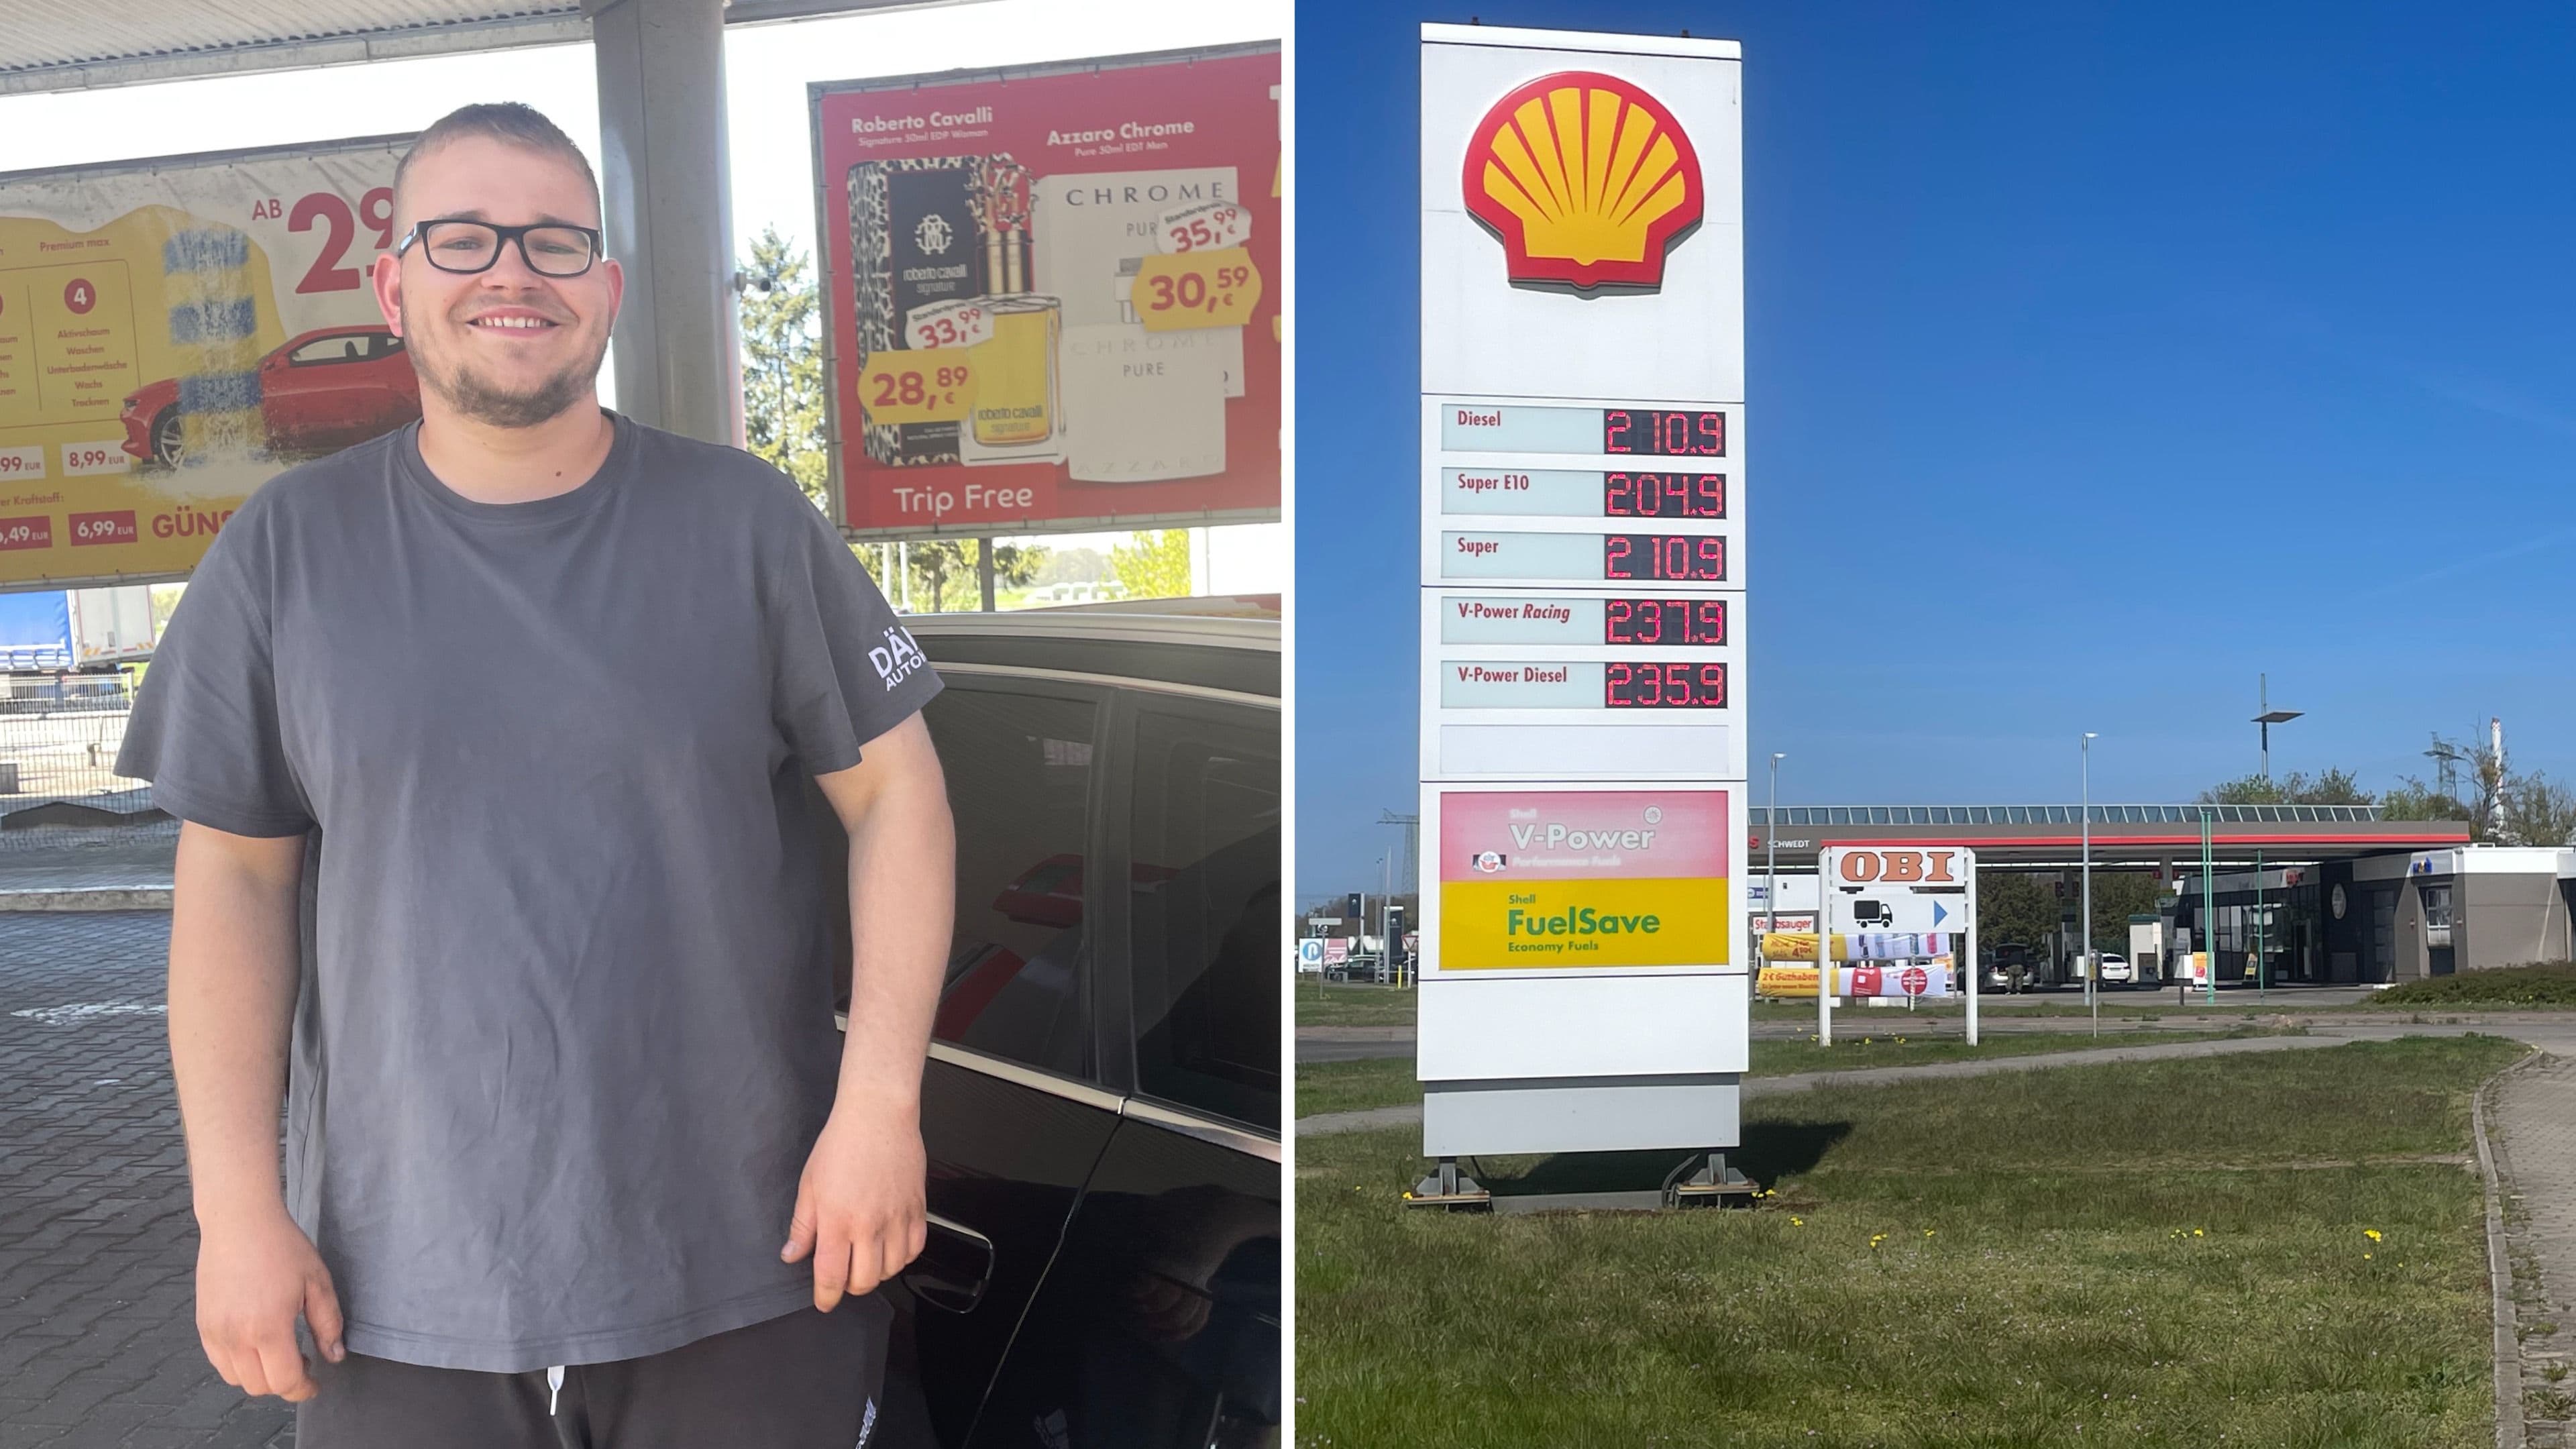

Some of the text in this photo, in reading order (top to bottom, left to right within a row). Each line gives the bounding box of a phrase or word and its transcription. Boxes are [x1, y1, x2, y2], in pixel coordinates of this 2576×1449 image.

[852, 107, 993, 133] Roberto Cavalli
[859, 138, 902, 147] Signature
[1047, 121, 1195, 146] Azzaro Chrome
[1075, 148, 1096, 156] Pure
[1066, 182, 1223, 205] CHROME
[252, 199, 282, 221] AB
[1126, 222, 1157, 236] PUR
[40, 238, 109, 252] Premium max
[74, 287, 87, 305] 4
[58, 328, 110, 338] Aktivschaum
[66, 345, 105, 355] Waschen
[1123, 362, 1165, 377] PURE
[74, 380, 103, 390] Wachs
[72, 398, 109, 407] Trocknen
[1458, 410, 1501, 426] Diesel
[1607, 411, 1722, 454] 210.9
[25, 462, 41, 470] EUR
[69, 451, 125, 469] 8,99 EUR
[1458, 474, 1529, 494] Super E10
[893, 484, 1032, 517] Trip Free
[1607, 473, 1723, 516] 204.9
[32, 531, 49, 541] EUR
[78, 520, 133, 539] 6,99 EUR
[1458, 537, 1499, 557] Super
[1607, 537, 1723, 579] 210.9
[1458, 602, 1570, 624] V-Power Racing
[1608, 600, 1723, 643] 237.9
[868, 626, 918, 678] DÄ
[1458, 666, 1567, 682] V-Power Diesel
[1608, 664, 1723, 706] 235.9
[1509, 809, 1538, 818] Shell
[1509, 823, 1656, 851] V-Power
[1840, 851, 1955, 881] OBI
[1509, 894, 1536, 904] Shell
[1509, 906, 1661, 935] FuelSave
[1509, 941, 1599, 953] Economy Fuels
